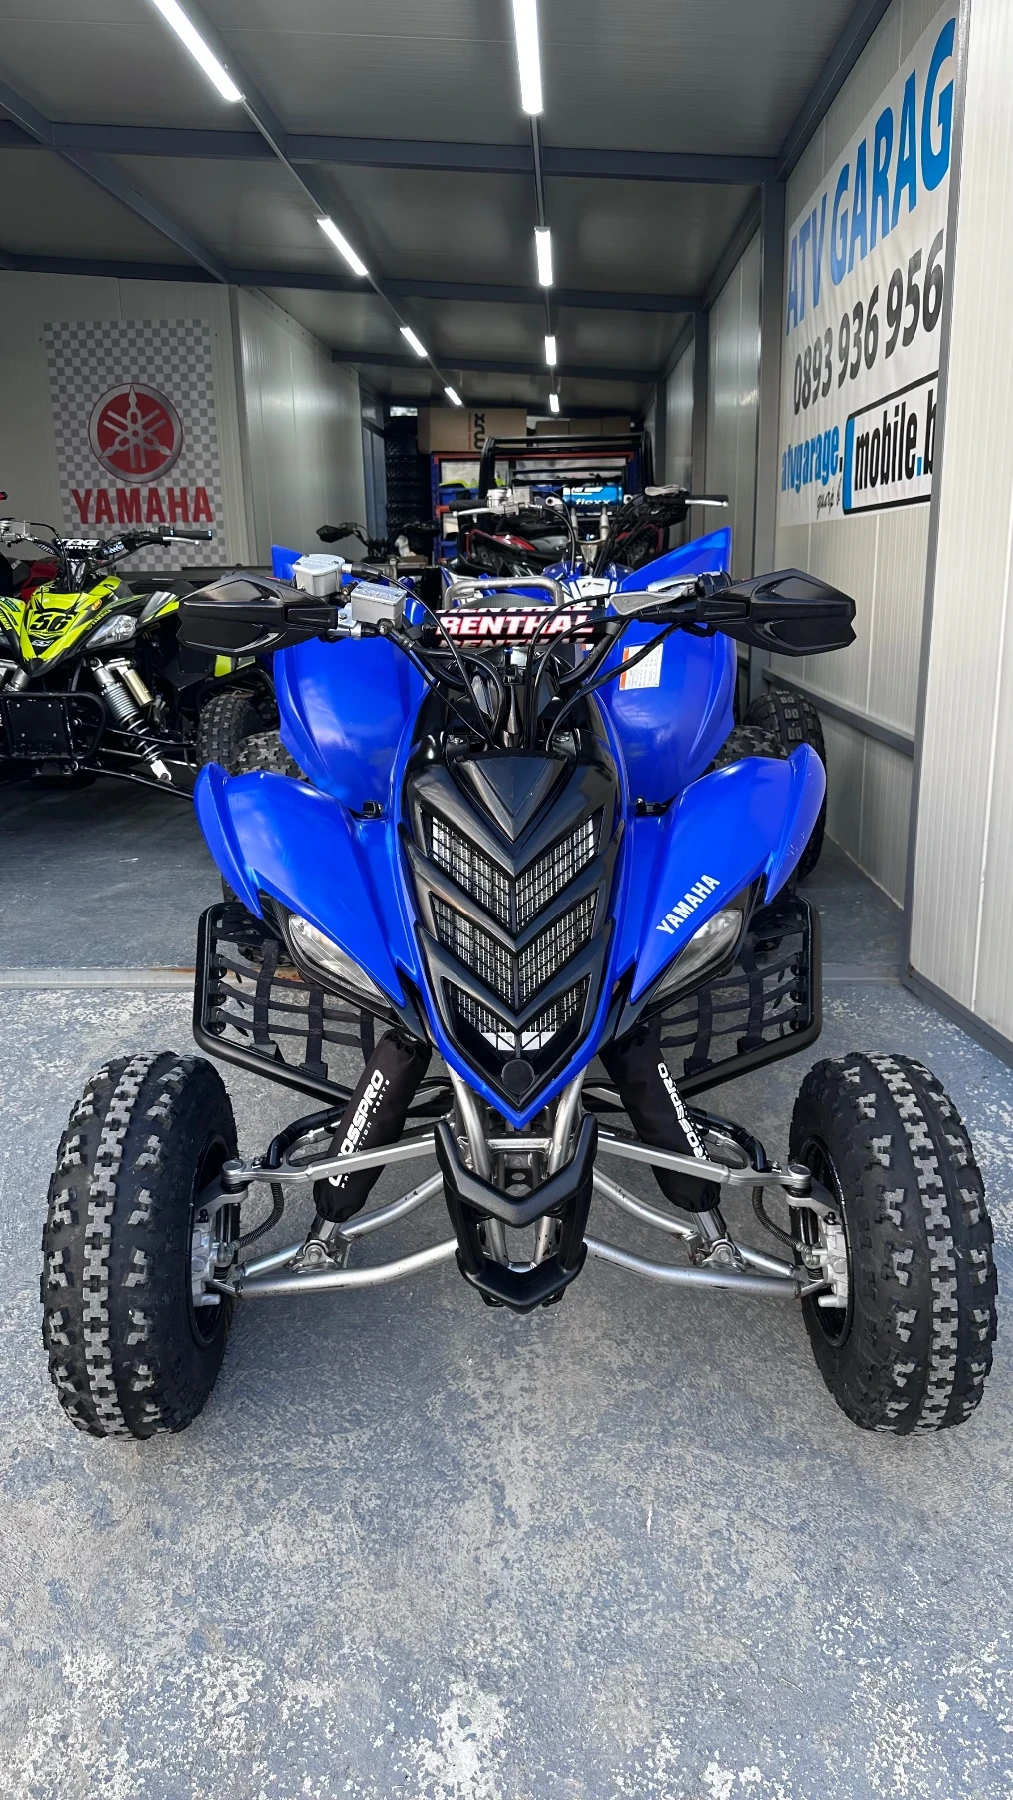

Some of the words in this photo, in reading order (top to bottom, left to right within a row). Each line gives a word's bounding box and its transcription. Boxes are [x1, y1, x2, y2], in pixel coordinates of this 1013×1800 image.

[786, 192, 827, 337] ATV
[830, 17, 956, 287] GARAG
[794, 327, 833, 416] 0893
[838, 284, 879, 389] 936
[885, 227, 944, 359] 956
[854, 388, 937, 491] mobile.b
[71, 486, 214, 525] YAMAHA
[29, 613, 73, 632] 56
[435, 614, 595, 636] RENTHAL
[656, 874, 721, 935] YAMAHA
[328, 1069, 384, 1187] COSSPRO
[657, 1062, 707, 1161] ROSSPRO
